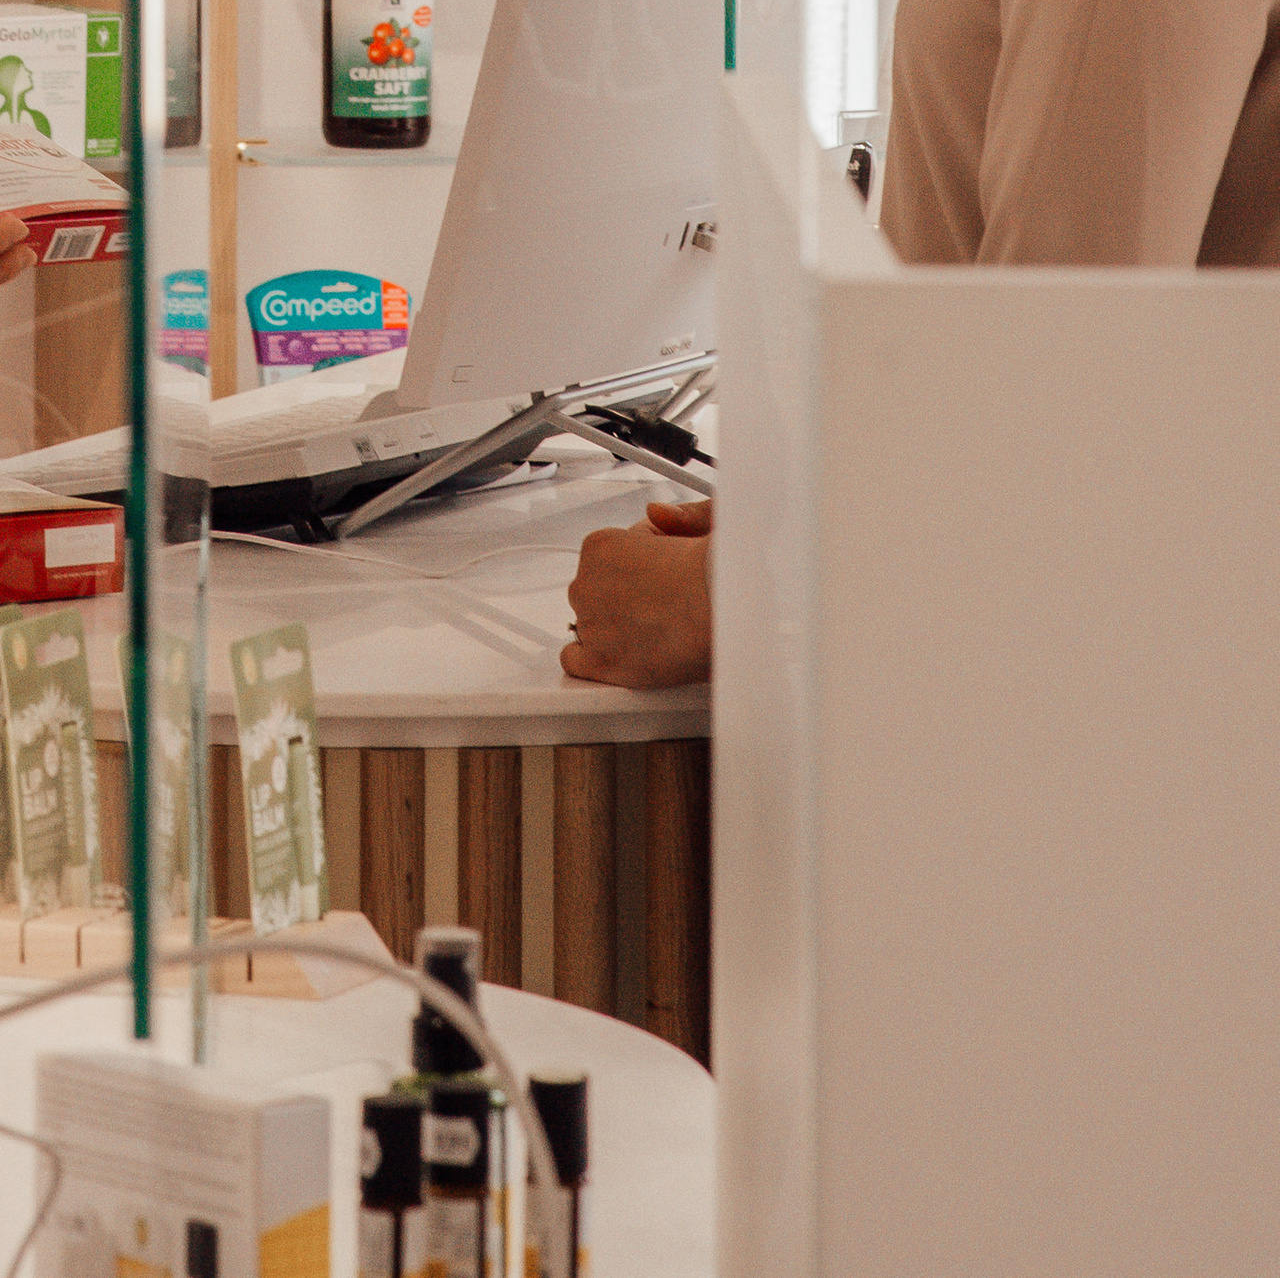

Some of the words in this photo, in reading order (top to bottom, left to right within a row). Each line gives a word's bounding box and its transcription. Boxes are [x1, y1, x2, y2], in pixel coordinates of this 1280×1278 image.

[0, 26, 77, 43] GeloMyrtol
[373, 81, 411, 96] SAFT
[260, 290, 377, 326] Compeed
